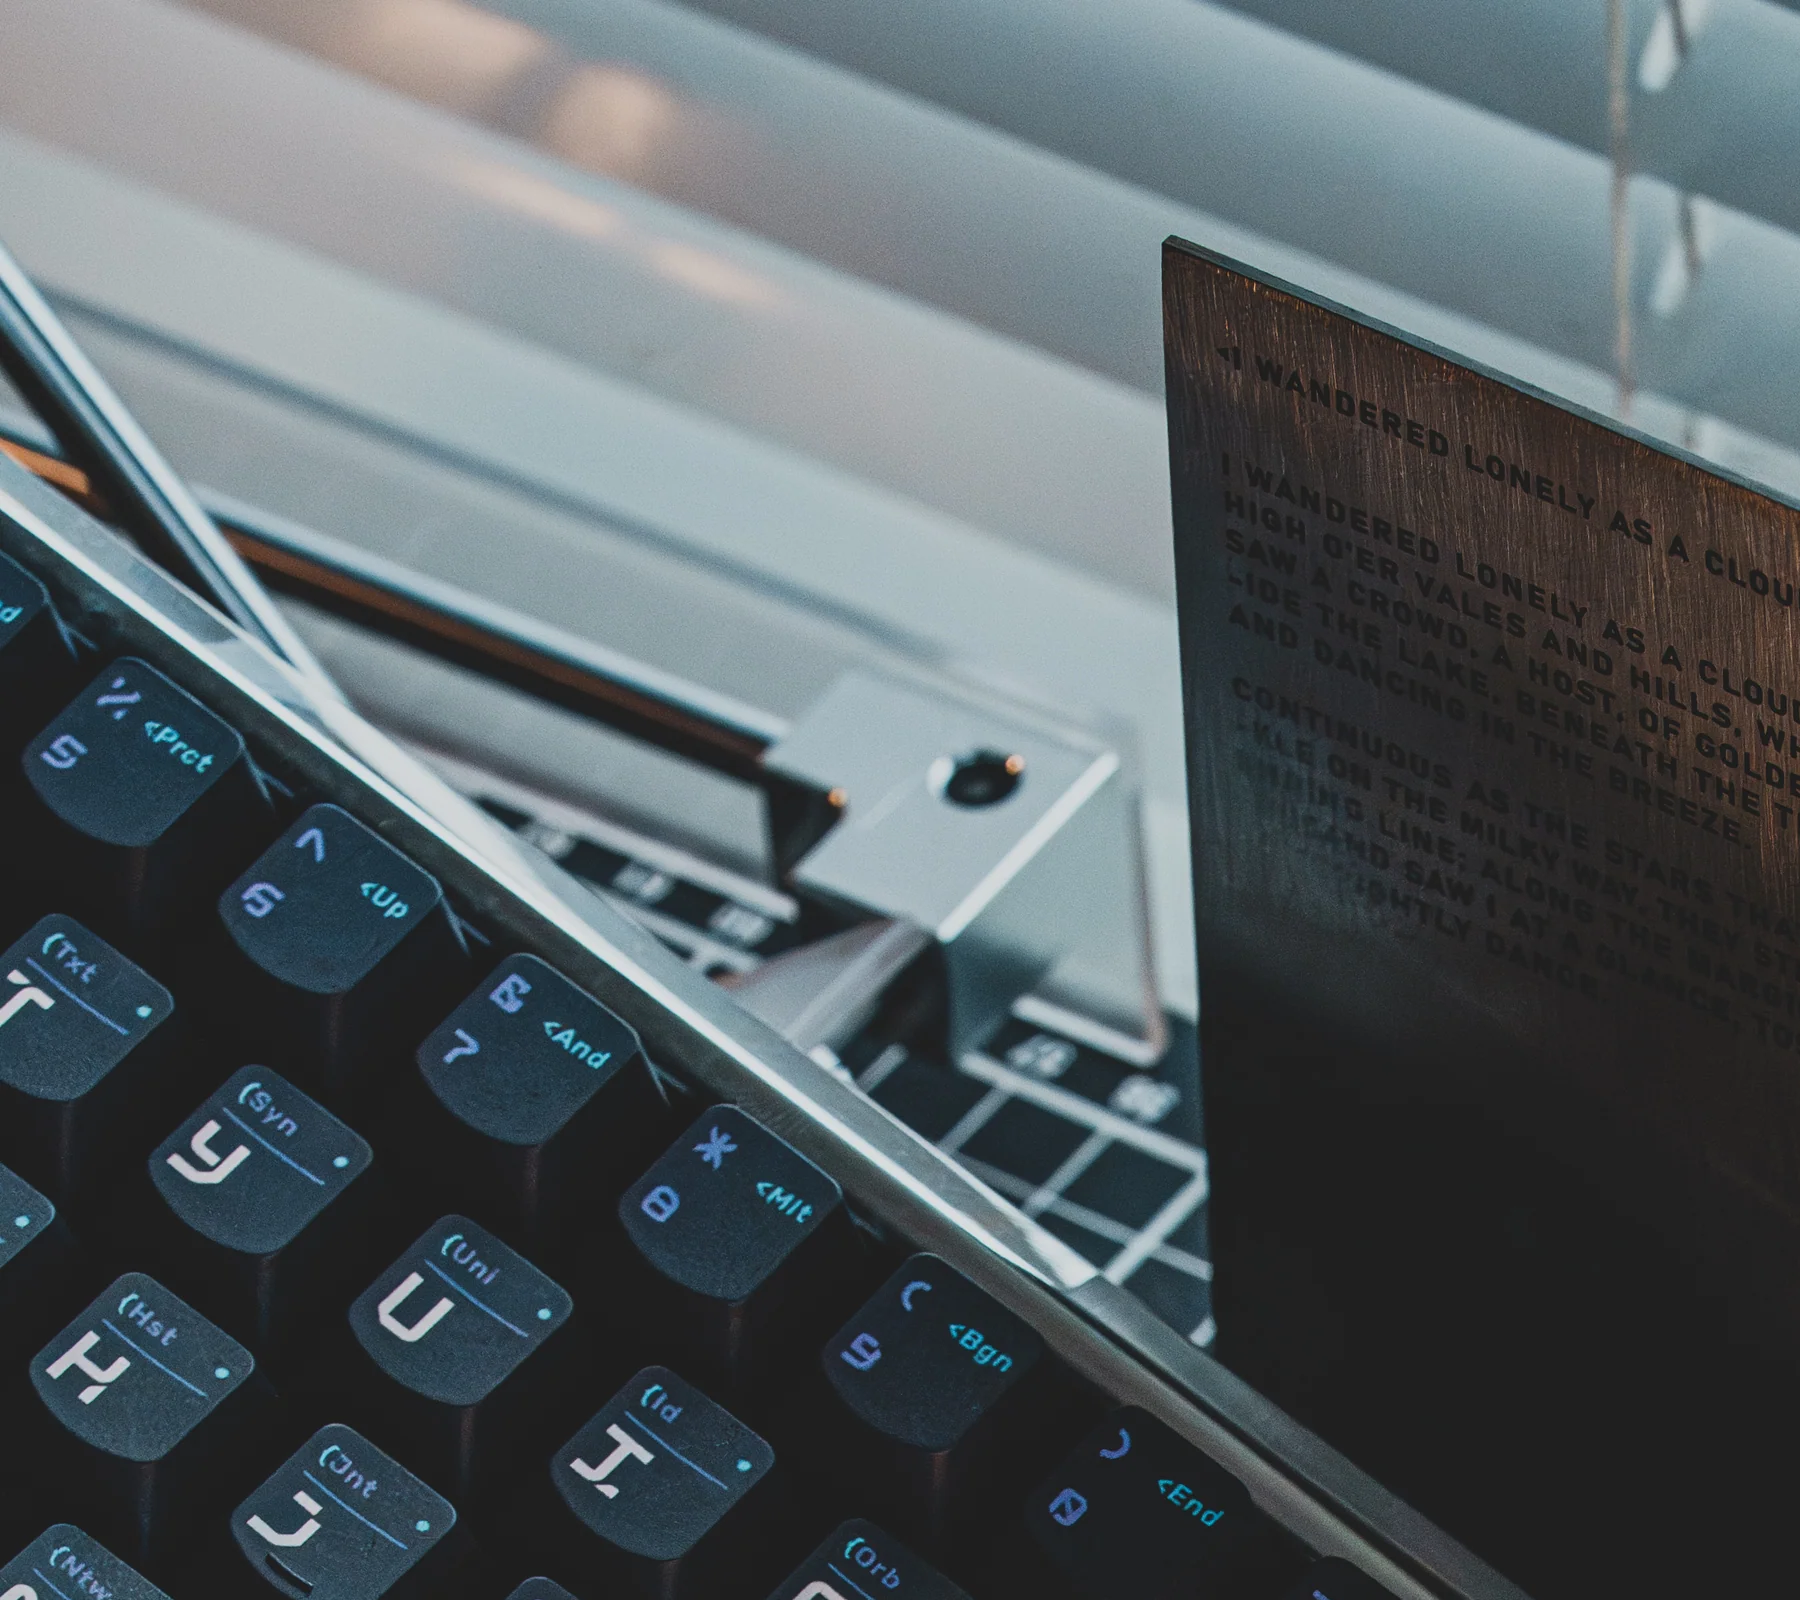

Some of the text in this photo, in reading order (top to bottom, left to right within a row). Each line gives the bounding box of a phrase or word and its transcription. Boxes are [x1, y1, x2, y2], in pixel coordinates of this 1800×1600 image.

[1254, 354, 1449, 458] WANDERED
[1463, 445, 1596, 520] LONELY
[1609, 511, 1653, 547] AS
[1667, 534, 1690, 564] A
[1225, 491, 1307, 546] HIGH
[1414, 571, 1526, 640] VALES
[1541, 628, 1614, 677] AND
[1245, 461, 1440, 565] WANDERED
[1455, 552, 1588, 629] LONELY
[1602, 619, 1645, 655] AS
[1661, 644, 1683, 673] A
[1310, 566, 1333, 595] A
[1491, 643, 1516, 673] A
[1638, 708, 1682, 742] OF
[41, 733, 88, 770] 5
[1314, 602, 1383, 652] THE
[1516, 690, 1678, 779] BENEATH
[1693, 766, 1761, 817] THE
[441, 1029, 480, 1065] 7
[45, 1329, 131, 1406] H
[377, 1271, 455, 1342] U
